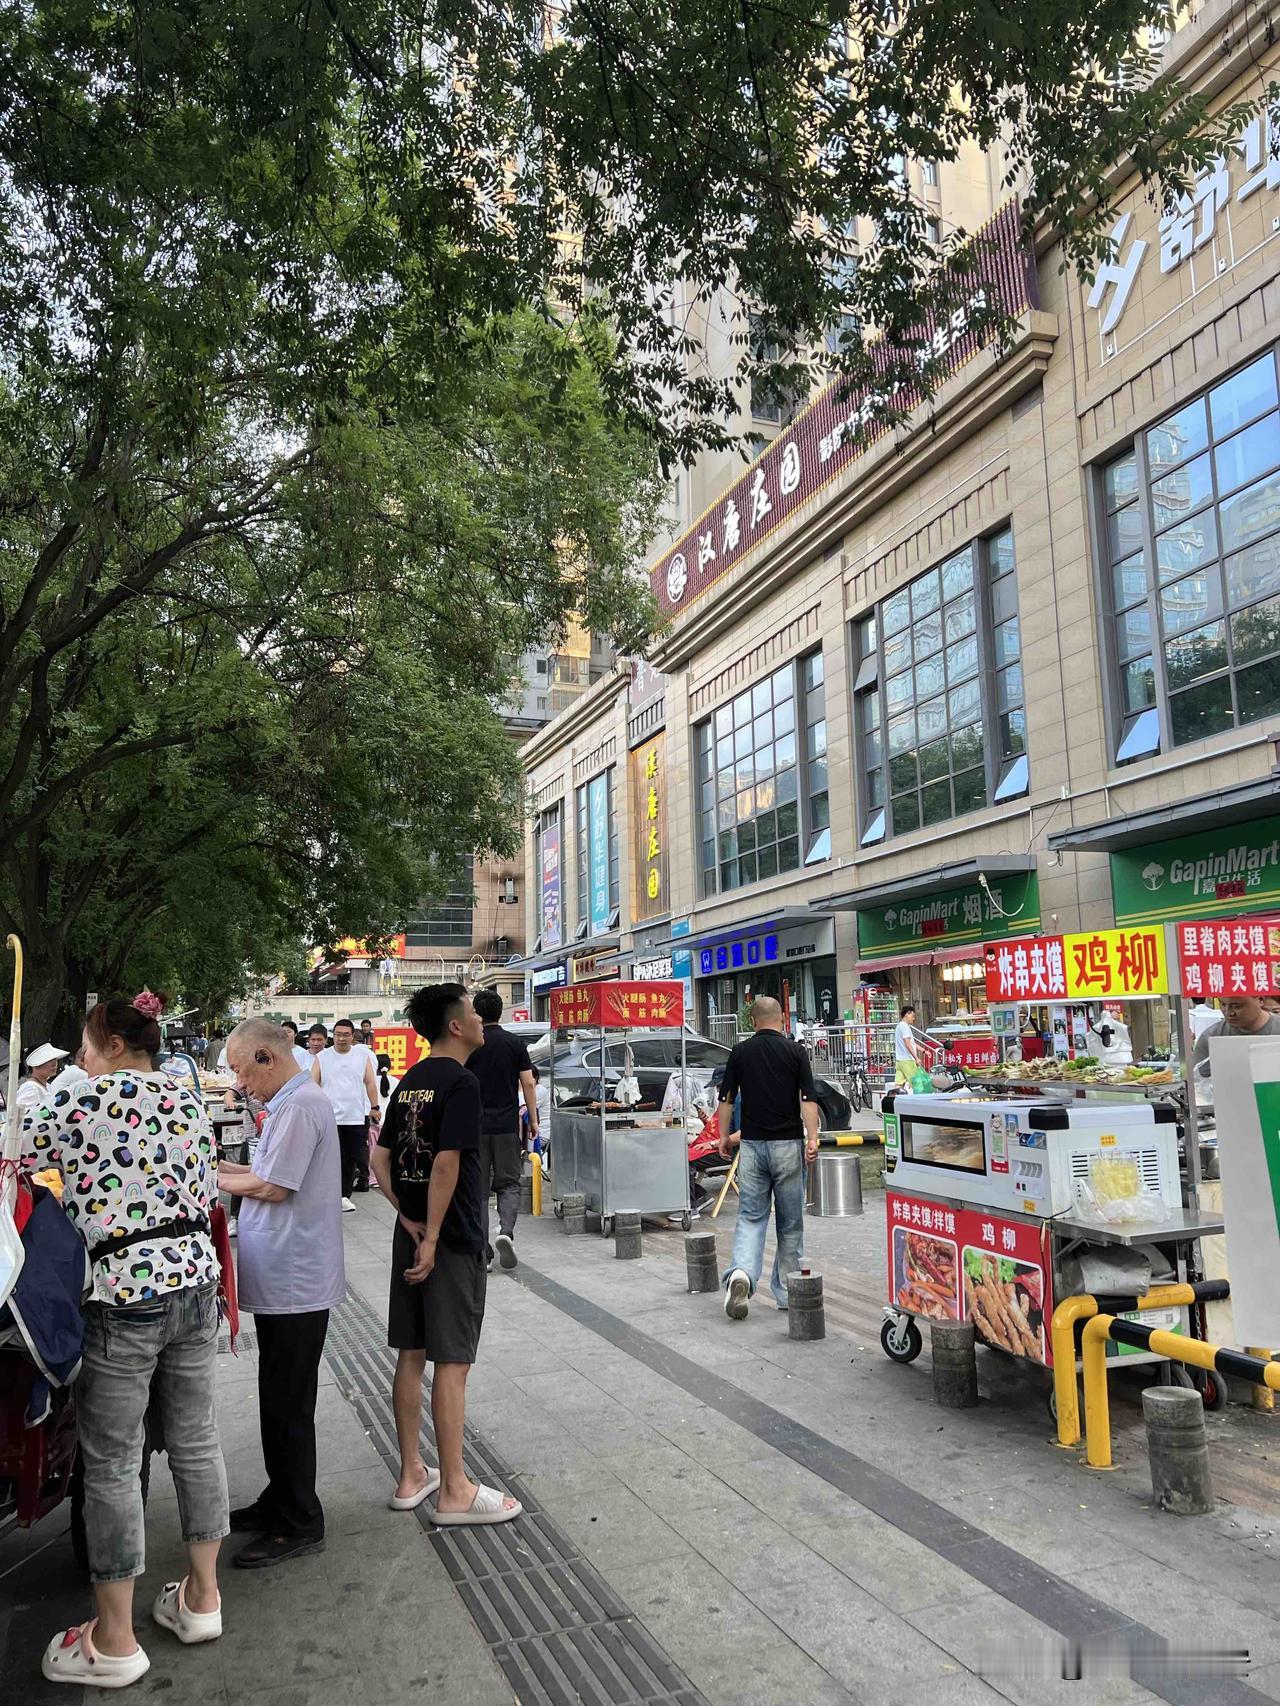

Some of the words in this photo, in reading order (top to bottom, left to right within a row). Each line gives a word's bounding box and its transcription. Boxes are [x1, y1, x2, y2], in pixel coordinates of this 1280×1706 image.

[1170, 840, 1280, 896] GapinMart
[900, 899, 958, 936] GapinMart
[963, 889, 1004, 925] 烟酒
[1183, 921, 1266, 957] 里脊肉夹馍
[998, 941, 1065, 997] 炸串夹馍
[1073, 932, 1159, 993] 鸡柳
[1185, 960, 1269, 994] 鸡柳夹馍
[622, 993, 647, 1004] 火腿肠
[650, 993, 667, 1004] 鱼丸
[650, 1007, 667, 1019] 肉肠
[892, 1199, 956, 1235] 炸串夹馍/拌馍
[981, 1222, 1016, 1251] 鸡柳
